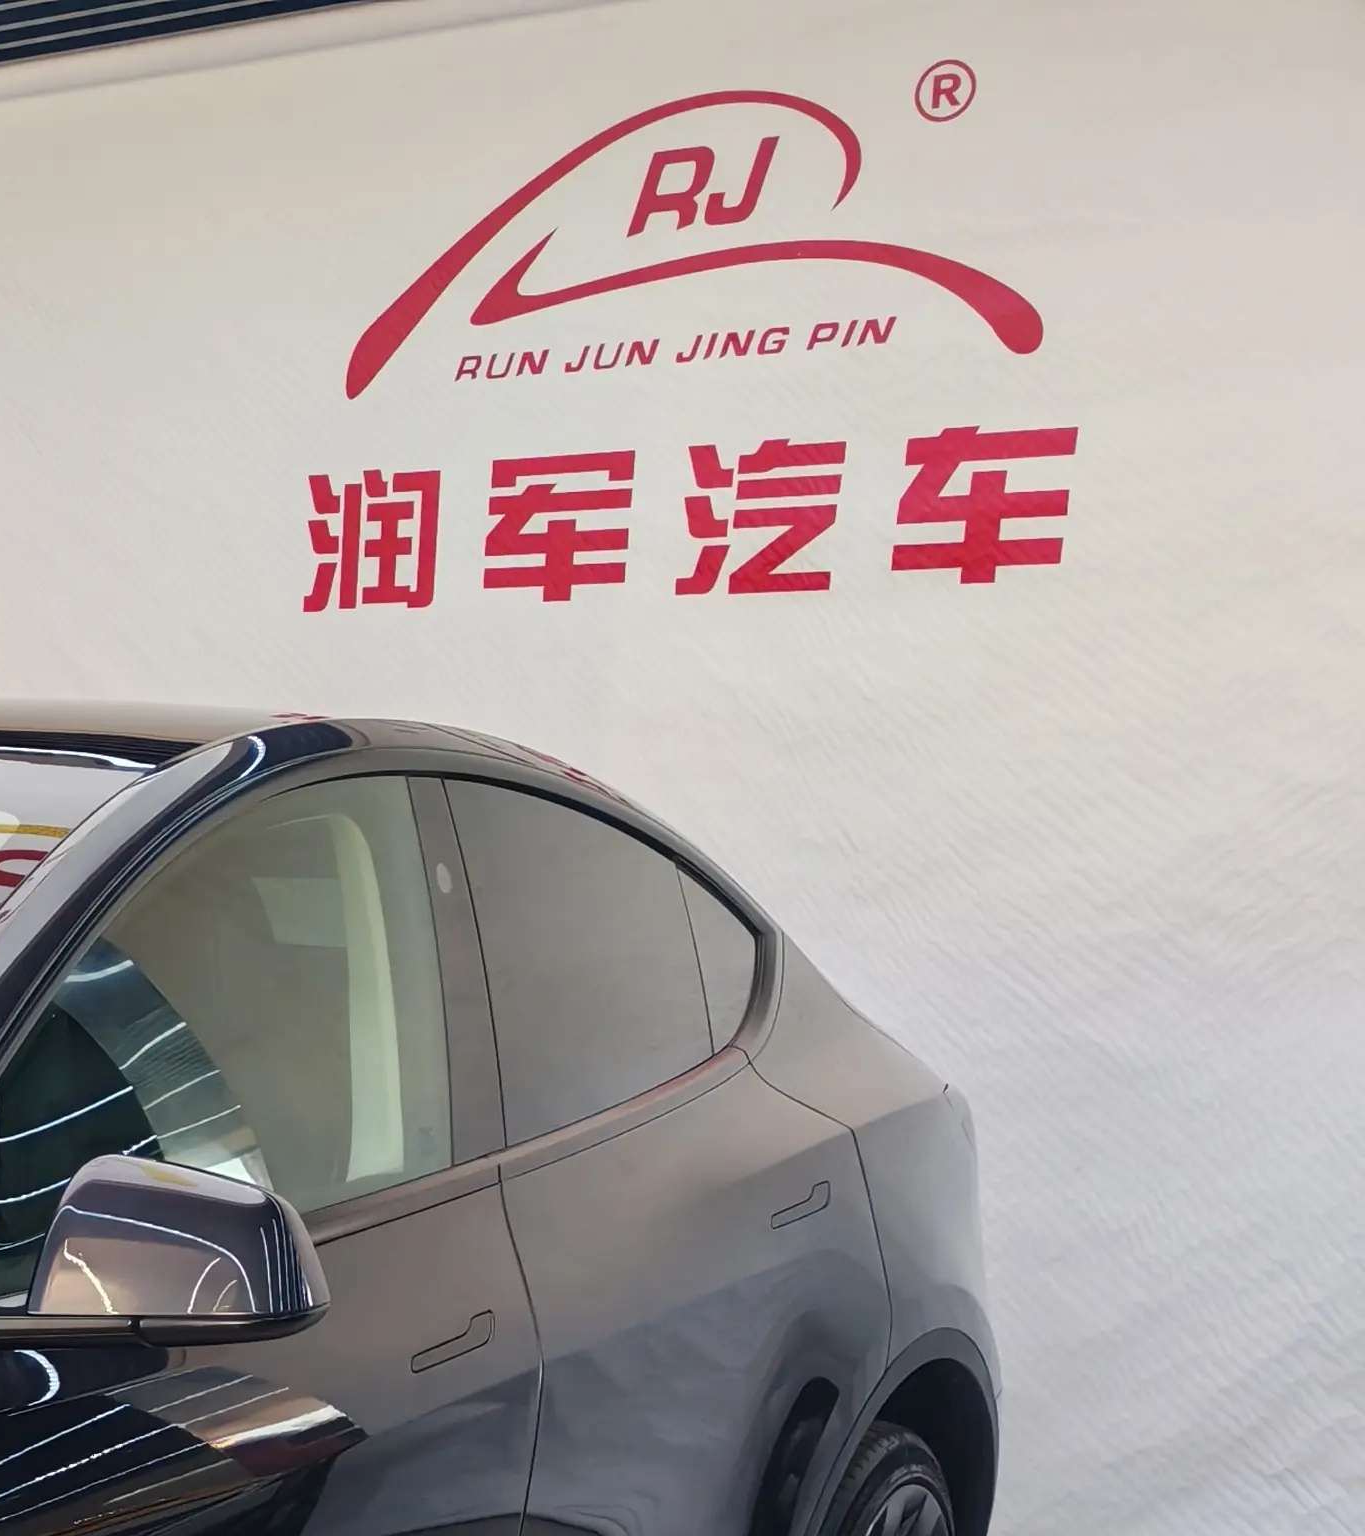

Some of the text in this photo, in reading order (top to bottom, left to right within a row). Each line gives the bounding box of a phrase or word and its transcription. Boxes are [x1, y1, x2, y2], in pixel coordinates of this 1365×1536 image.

[627, 136, 779, 238] RJ
[454, 316, 896, 382] RUN JUN JING PIN
[303, 425, 1079, 613] 润军汽车
